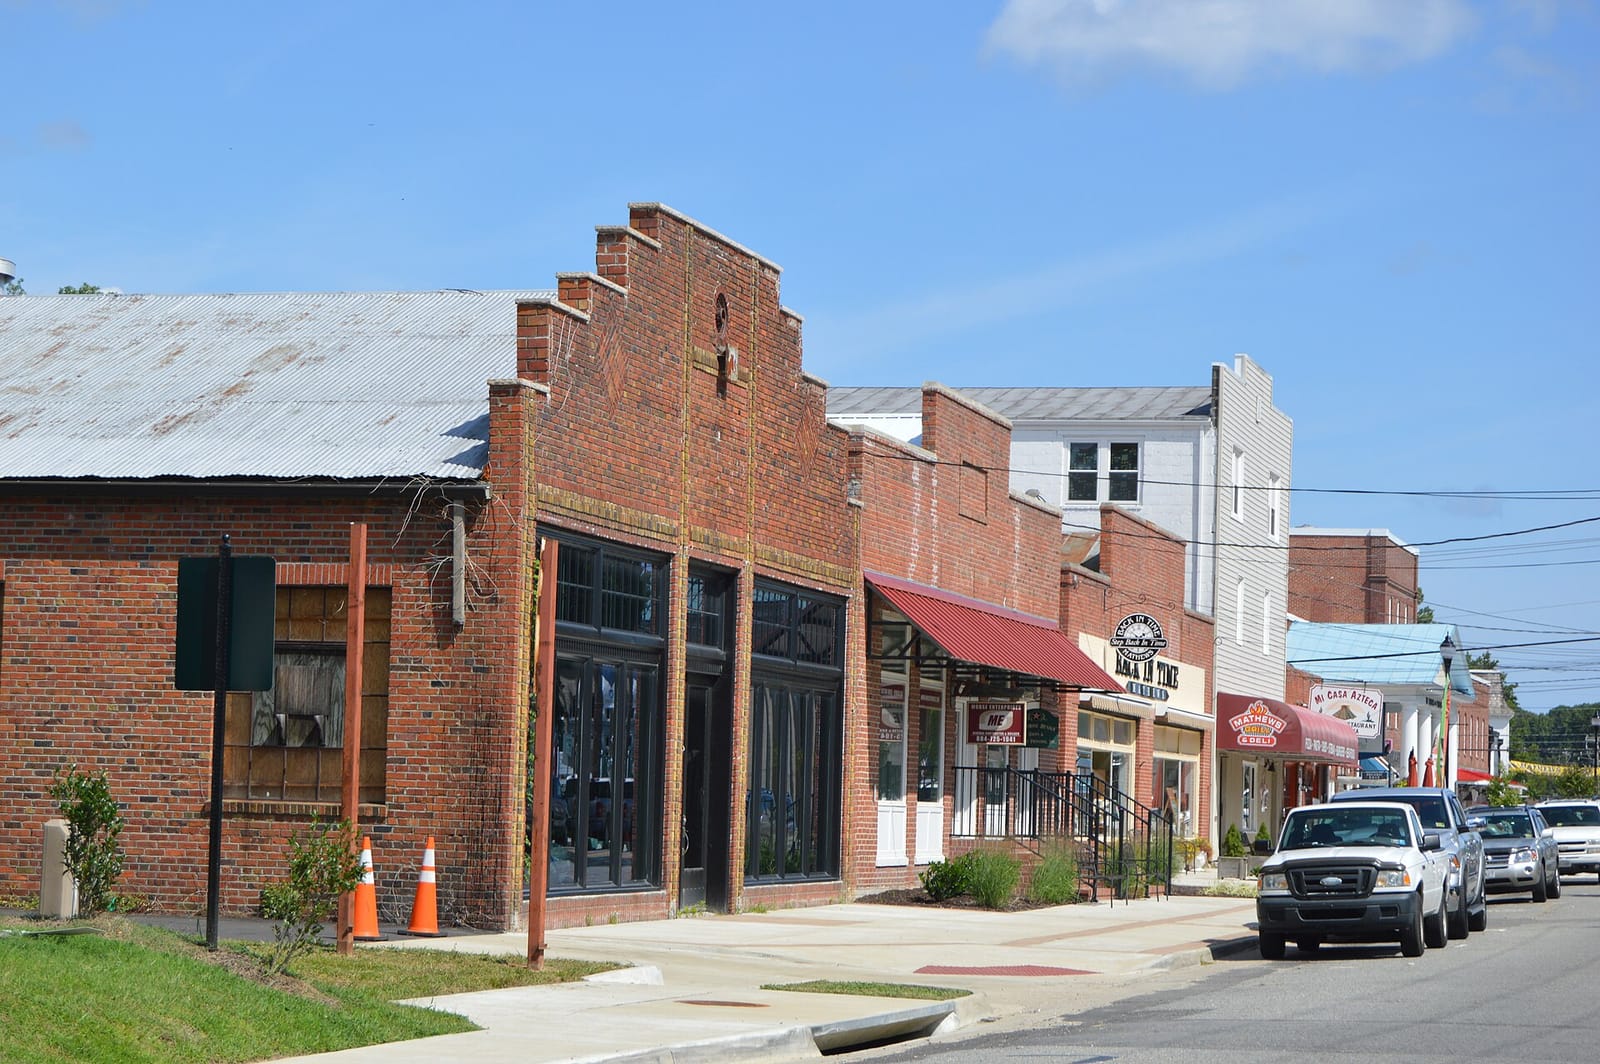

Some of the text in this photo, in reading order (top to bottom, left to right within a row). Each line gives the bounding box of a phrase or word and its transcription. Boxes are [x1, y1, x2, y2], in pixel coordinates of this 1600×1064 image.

[1118, 615, 1161, 638] BACK IN TIME
[1125, 639, 1140, 647] Back
[1122, 648, 1155, 661] MATHEWS
[1156, 660, 1179, 690] TIME
[1327, 690, 1348, 700] CASA
[1350, 690, 1378, 711] AZTECA
[987, 714, 1006, 727] ME
[1233, 714, 1283, 729] MATHEWS
[1244, 725, 1272, 735] GRILL
